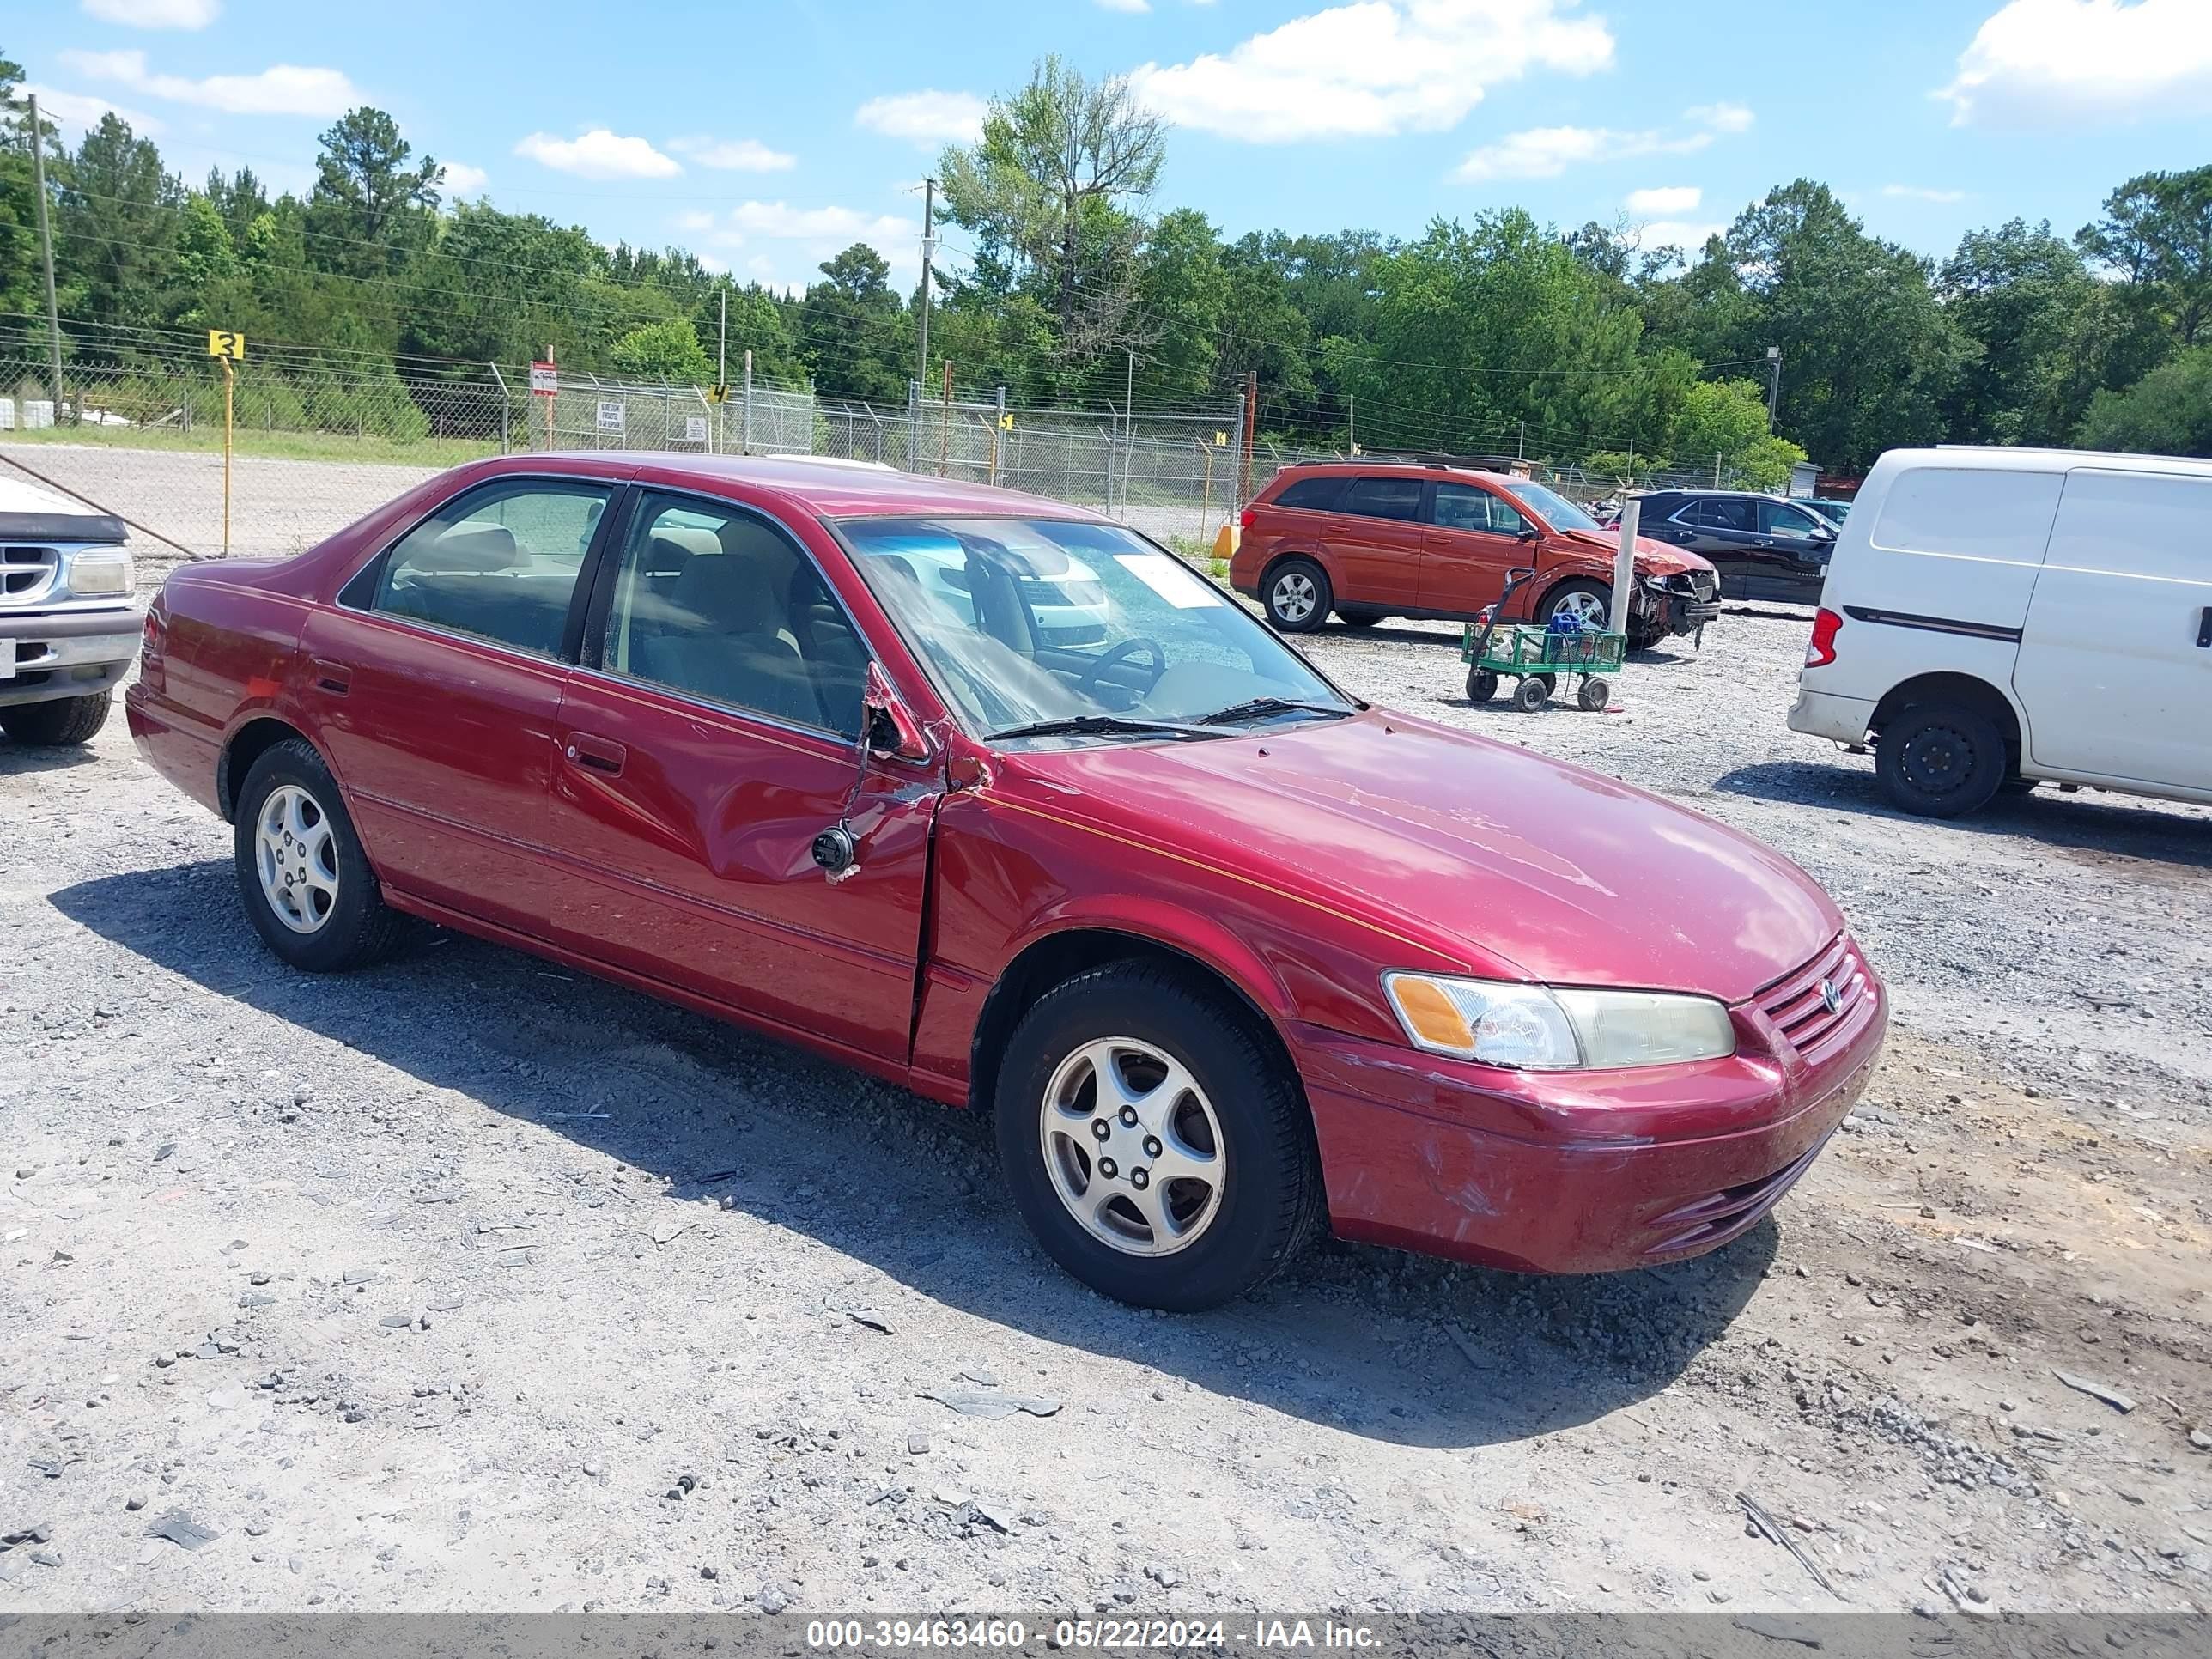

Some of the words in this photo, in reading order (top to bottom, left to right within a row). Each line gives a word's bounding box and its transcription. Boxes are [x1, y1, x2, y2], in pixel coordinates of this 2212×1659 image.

[217, 333, 236, 357] 3
[714, 385, 726, 403] 4
[1000, 415, 1009, 429] 5
